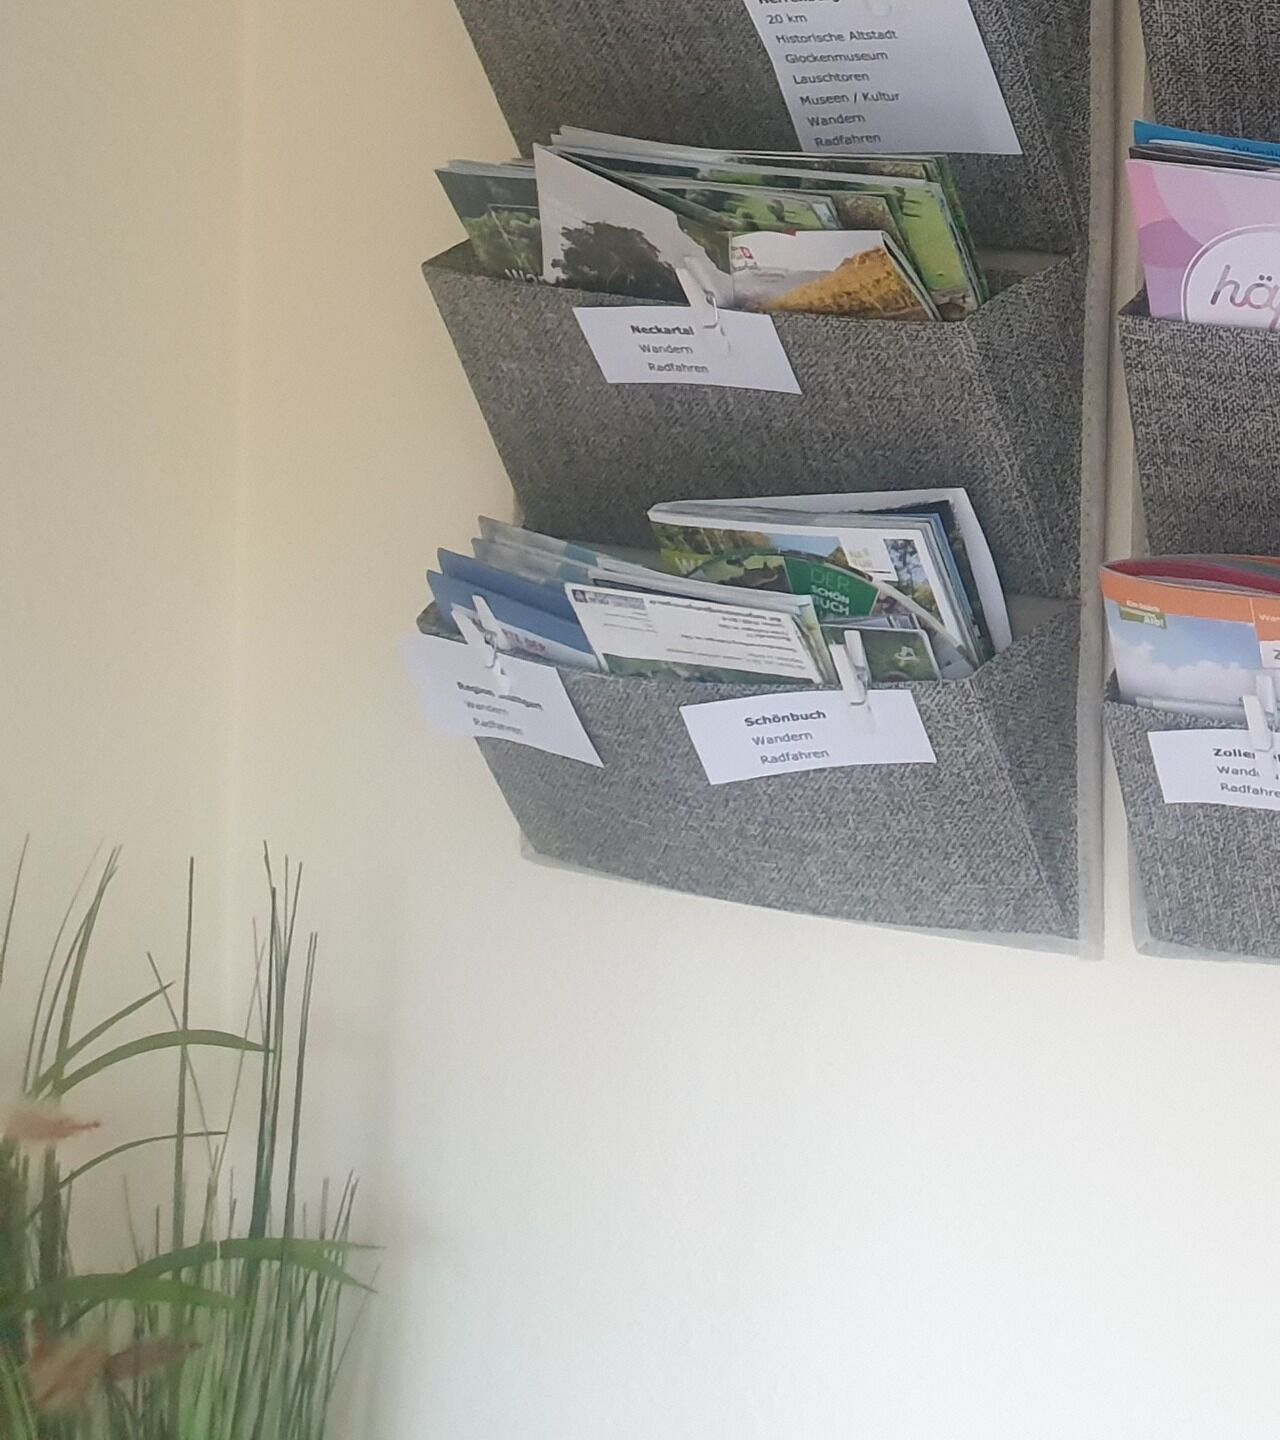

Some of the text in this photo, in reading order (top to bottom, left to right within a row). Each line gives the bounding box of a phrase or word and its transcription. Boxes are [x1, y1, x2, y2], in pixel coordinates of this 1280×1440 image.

[768, 13, 807, 24] 20 km
[776, 29, 898, 44] Historische Altstadt
[785, 50, 888, 64] Glockenmuseum
[793, 71, 870, 85] Lauschtoren
[800, 93, 849, 106] Museen
[862, 91, 900, 102] Kultur
[807, 114, 865, 127] Wandern
[814, 133, 881, 148] Radfahren
[631, 325, 694, 336] Neckartal
[648, 363, 709, 373] Radfahren
[811, 566, 849, 591] DER
[744, 710, 826, 727] Schönbuch
[752, 731, 813, 746] Wandern
[760, 749, 829, 764] Radfahren
